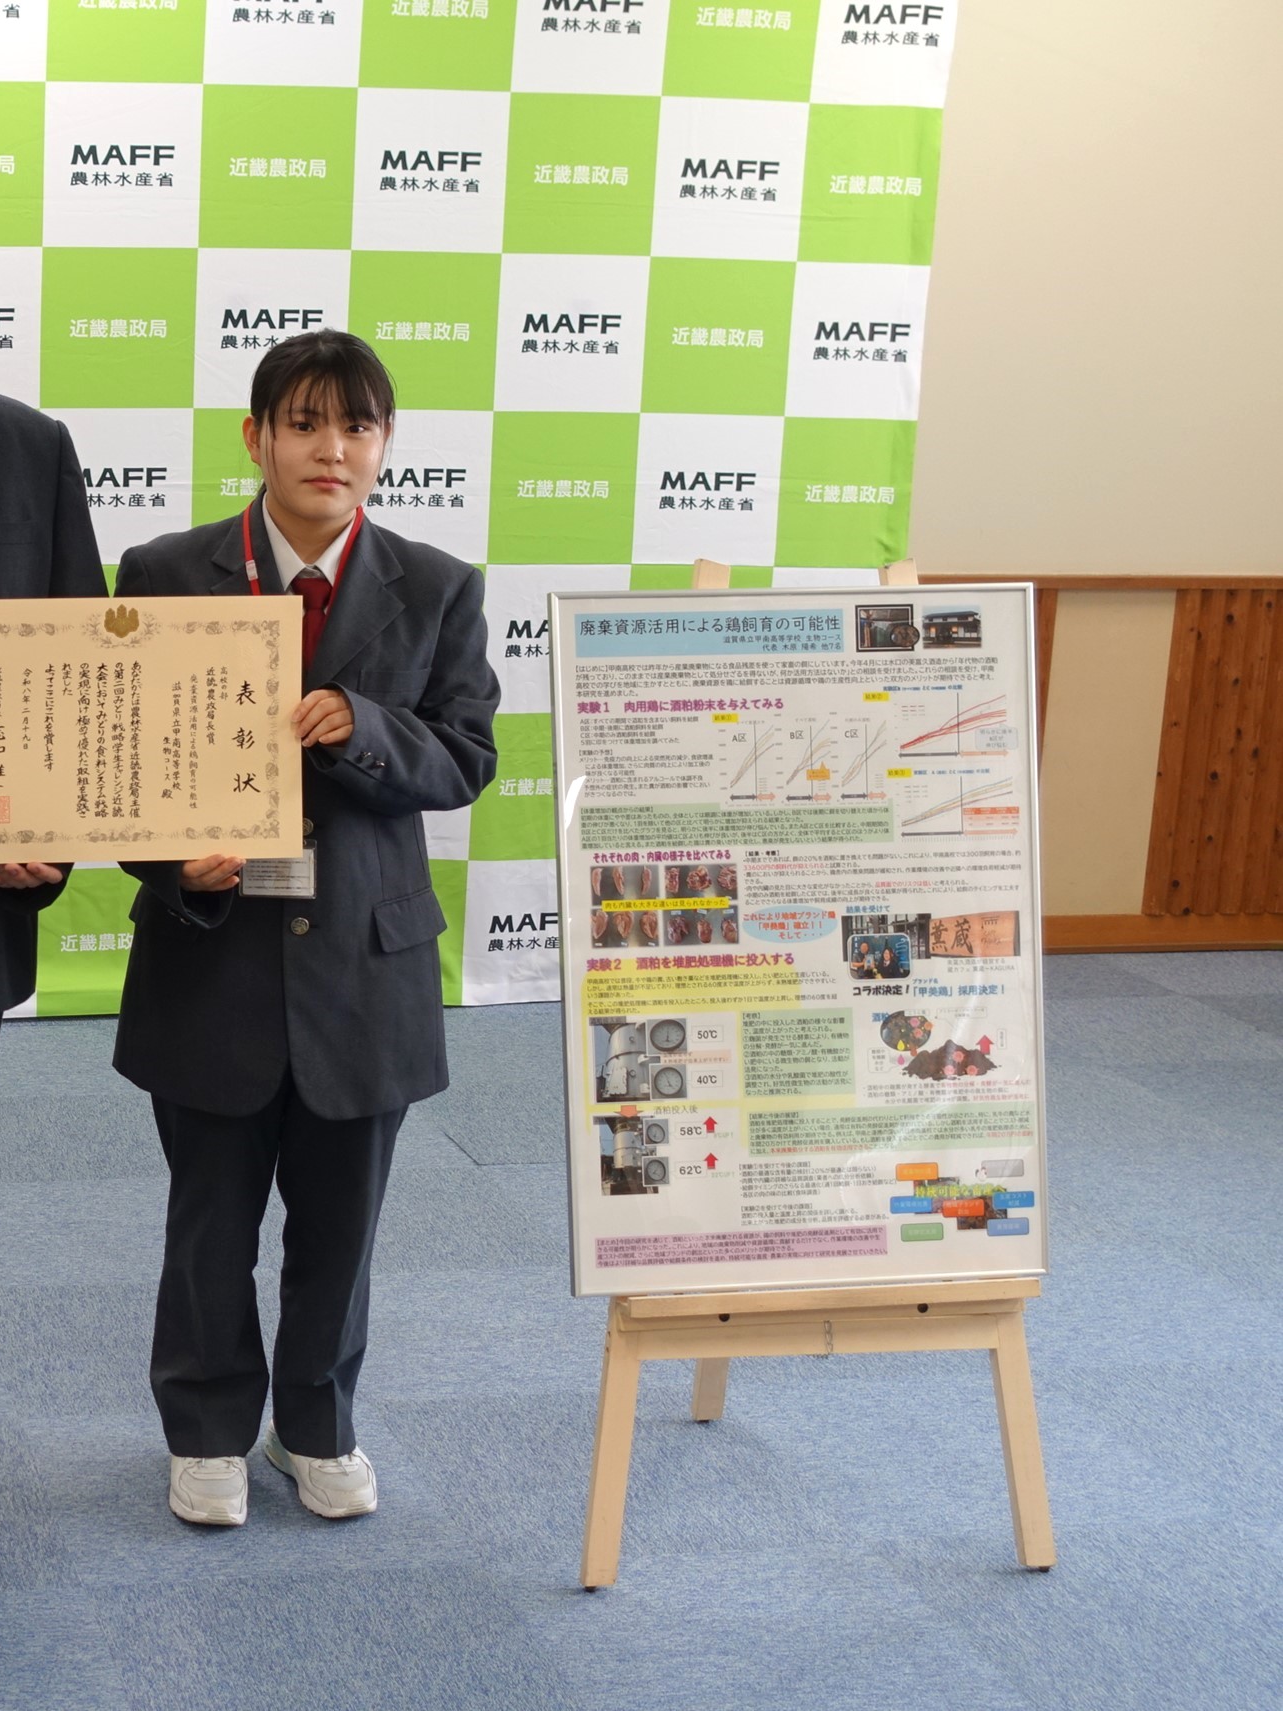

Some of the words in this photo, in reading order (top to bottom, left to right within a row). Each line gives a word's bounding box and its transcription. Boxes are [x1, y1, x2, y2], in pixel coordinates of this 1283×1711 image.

[233, 8, 335, 24] 農林水産省
[392, 0, 488, 18] 近畿農政局
[844, 4, 943, 25] MAFF
[541, 17, 641, 34] 農林水産省
[697, 7, 791, 30] 近畿農政局
[842, 31, 939, 47] 農林水産省
[71, 145, 175, 165] MAFF
[381, 150, 481, 172] MAFF
[230, 158, 326, 178] 近畿農政局
[534, 165, 628, 185] 近畿農政局
[681, 159, 779, 180] MAFF
[71, 172, 173, 186] 農林水産省
[380, 177, 479, 192] 農林水産省
[830, 176, 921, 196] 近畿農政局
[680, 184, 776, 201] 農林水産省
[222, 309, 323, 329] MAFF
[523, 314, 621, 334] MAFF
[70, 319, 167, 338] 近畿農政局
[376, 322, 469, 341] 近畿農政局
[672, 327, 764, 348] 近畿農政局
[815, 322, 910, 342] MAFF
[522, 339, 618, 354] 農林水産省
[813, 347, 907, 362] 農林水産省
[518, 480, 609, 498] 近畿農政局
[660, 472, 756, 491] MAFF
[367, 493, 463, 507] 農林水産省
[659, 496, 753, 510] 農林水産省
[806, 485, 894, 504] 近畿農政局
[579, 618, 841, 637] 廃棄資源活用による鶏飼育の可能性
[806, 634, 841, 642] 生物コース
[762, 644, 777, 652] 代表
[577, 702, 609, 714] 実験1
[624, 699, 784, 713] 肉用鶏に酒粕粉末を与えてみる
[231, 680, 261, 793] 表彰状
[732, 733, 747, 742] A区
[790, 730, 805, 740] B区
[844, 729, 859, 738] C区
[586, 958, 622, 971] 実験2
[636, 953, 794, 970] 酒粕を堆肥処理機に投入する
[697, 1030, 718, 1039] 50℃
[697, 1075, 717, 1084] 40℃
[680, 1127, 702, 1136] 58℃
[679, 1166, 702, 1175] 62℃
